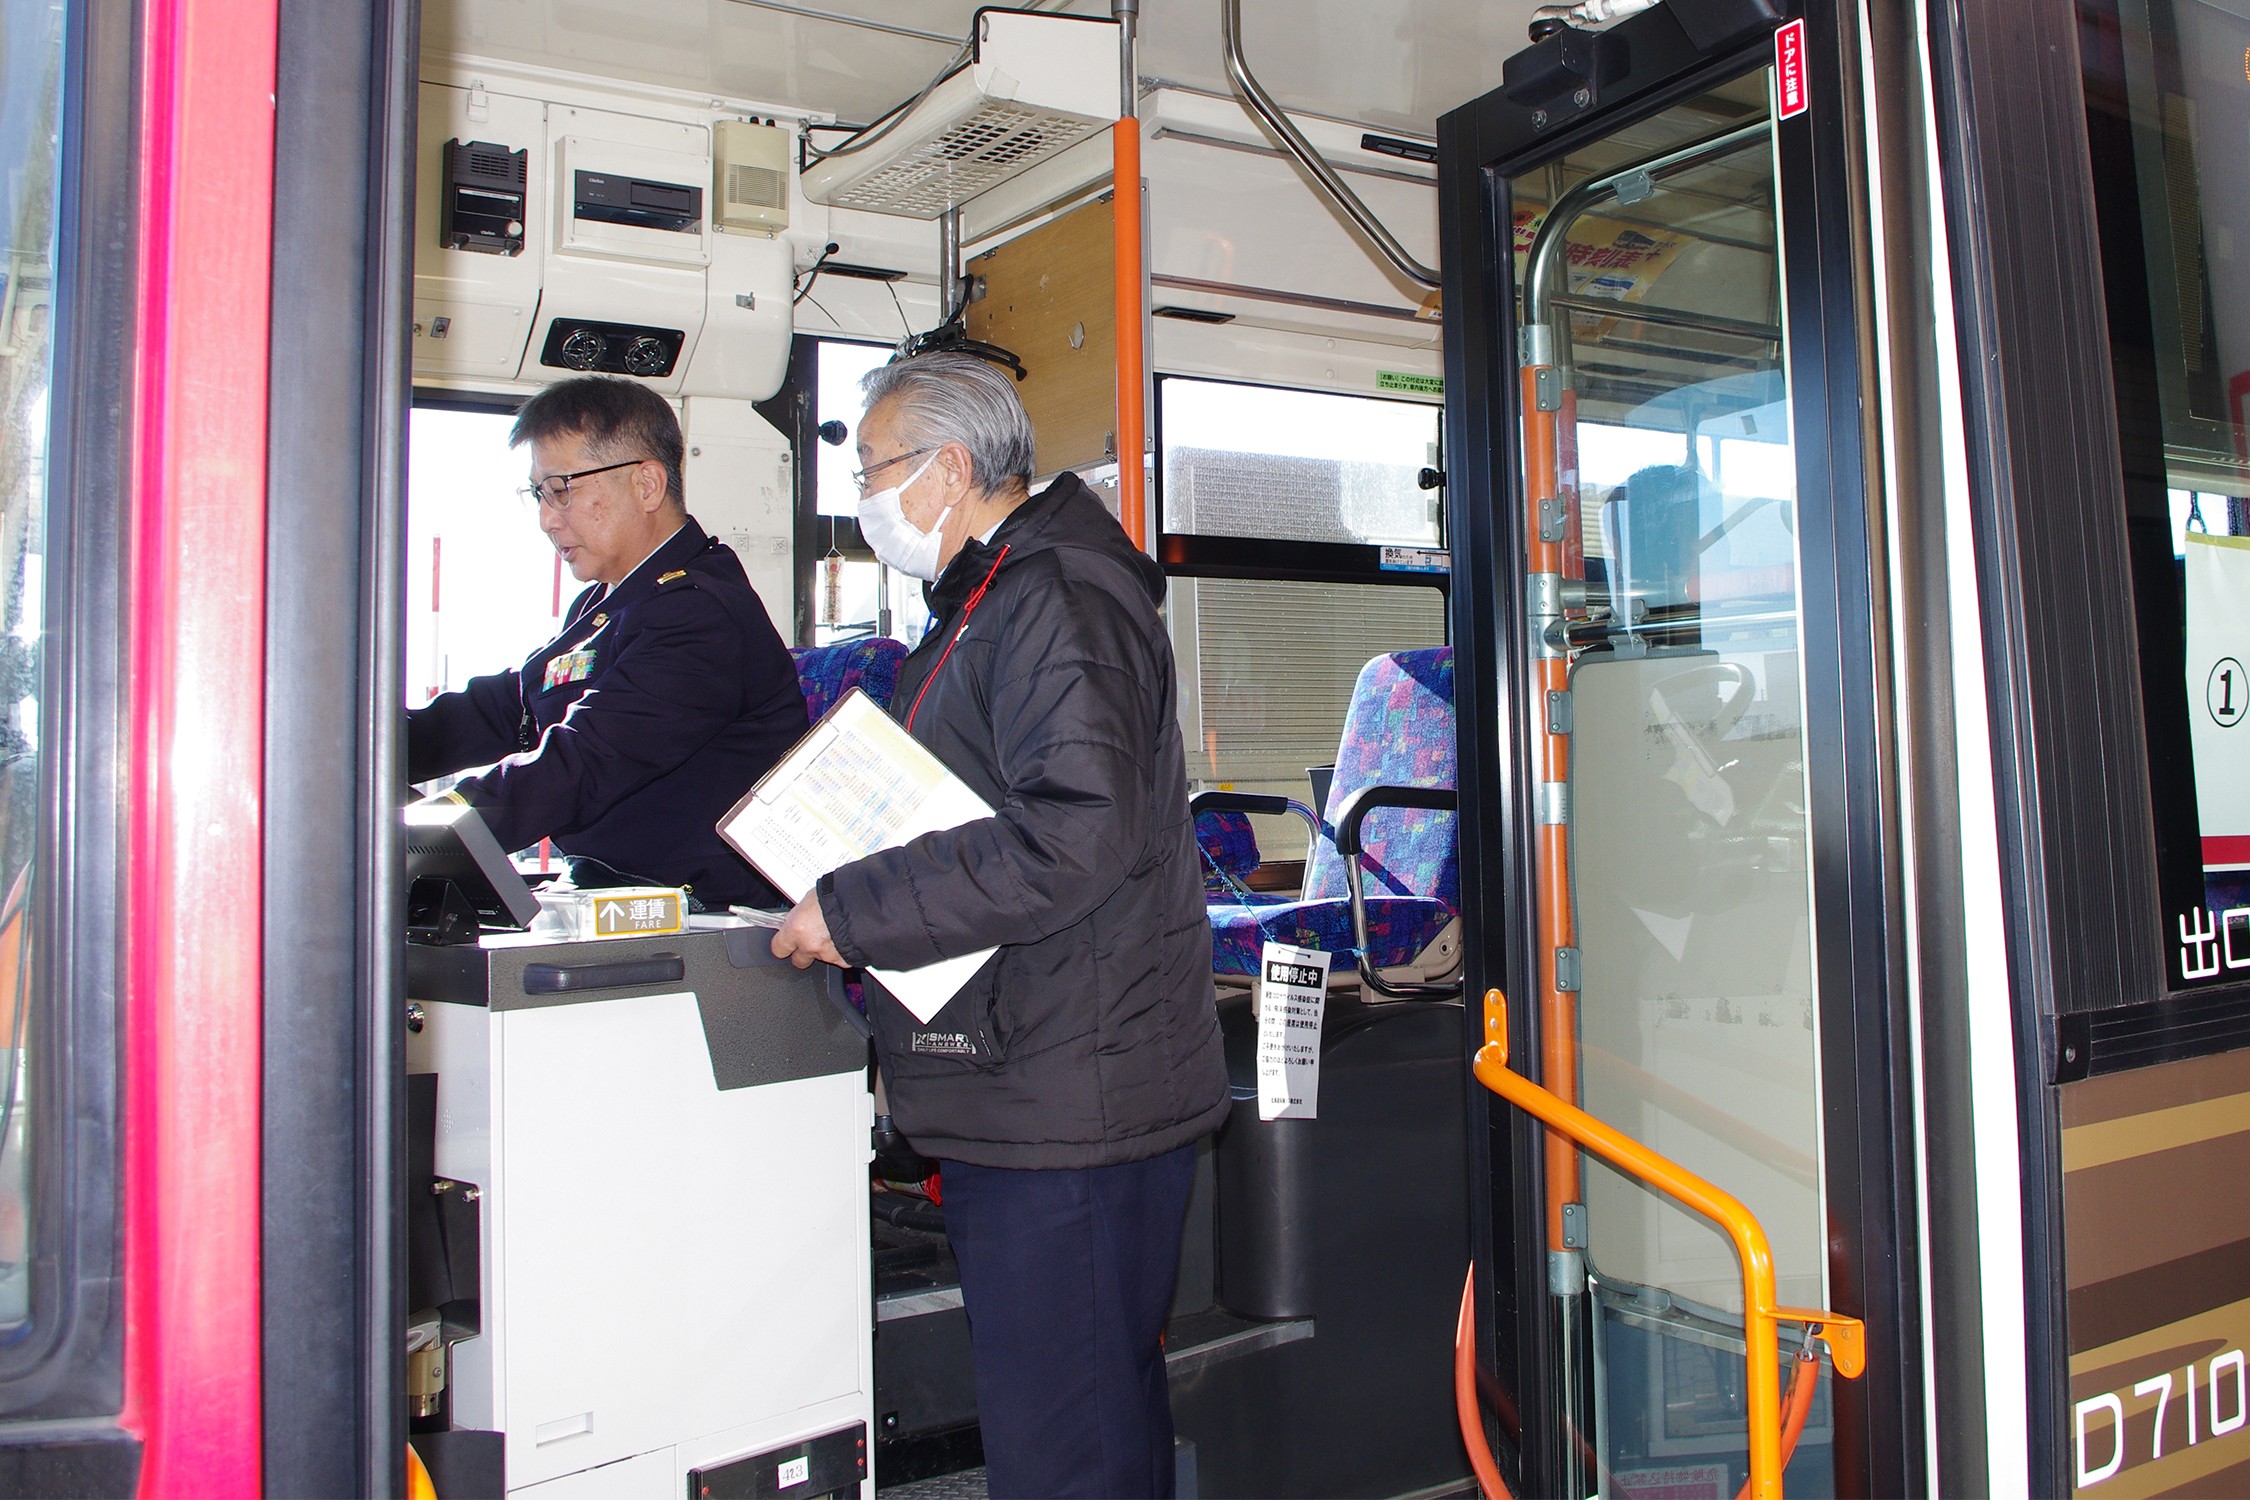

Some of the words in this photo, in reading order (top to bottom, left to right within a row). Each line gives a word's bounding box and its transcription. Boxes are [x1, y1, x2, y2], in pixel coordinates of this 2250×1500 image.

[1784, 32, 1798, 107] ドアに注意
[629, 898, 665, 920] 運賃
[635, 920, 661, 929] FARE
[2179, 906, 2250, 980] 出口
[1271, 964, 1318, 985] 使用停止中
[2075, 1349, 2248, 1489] D710
